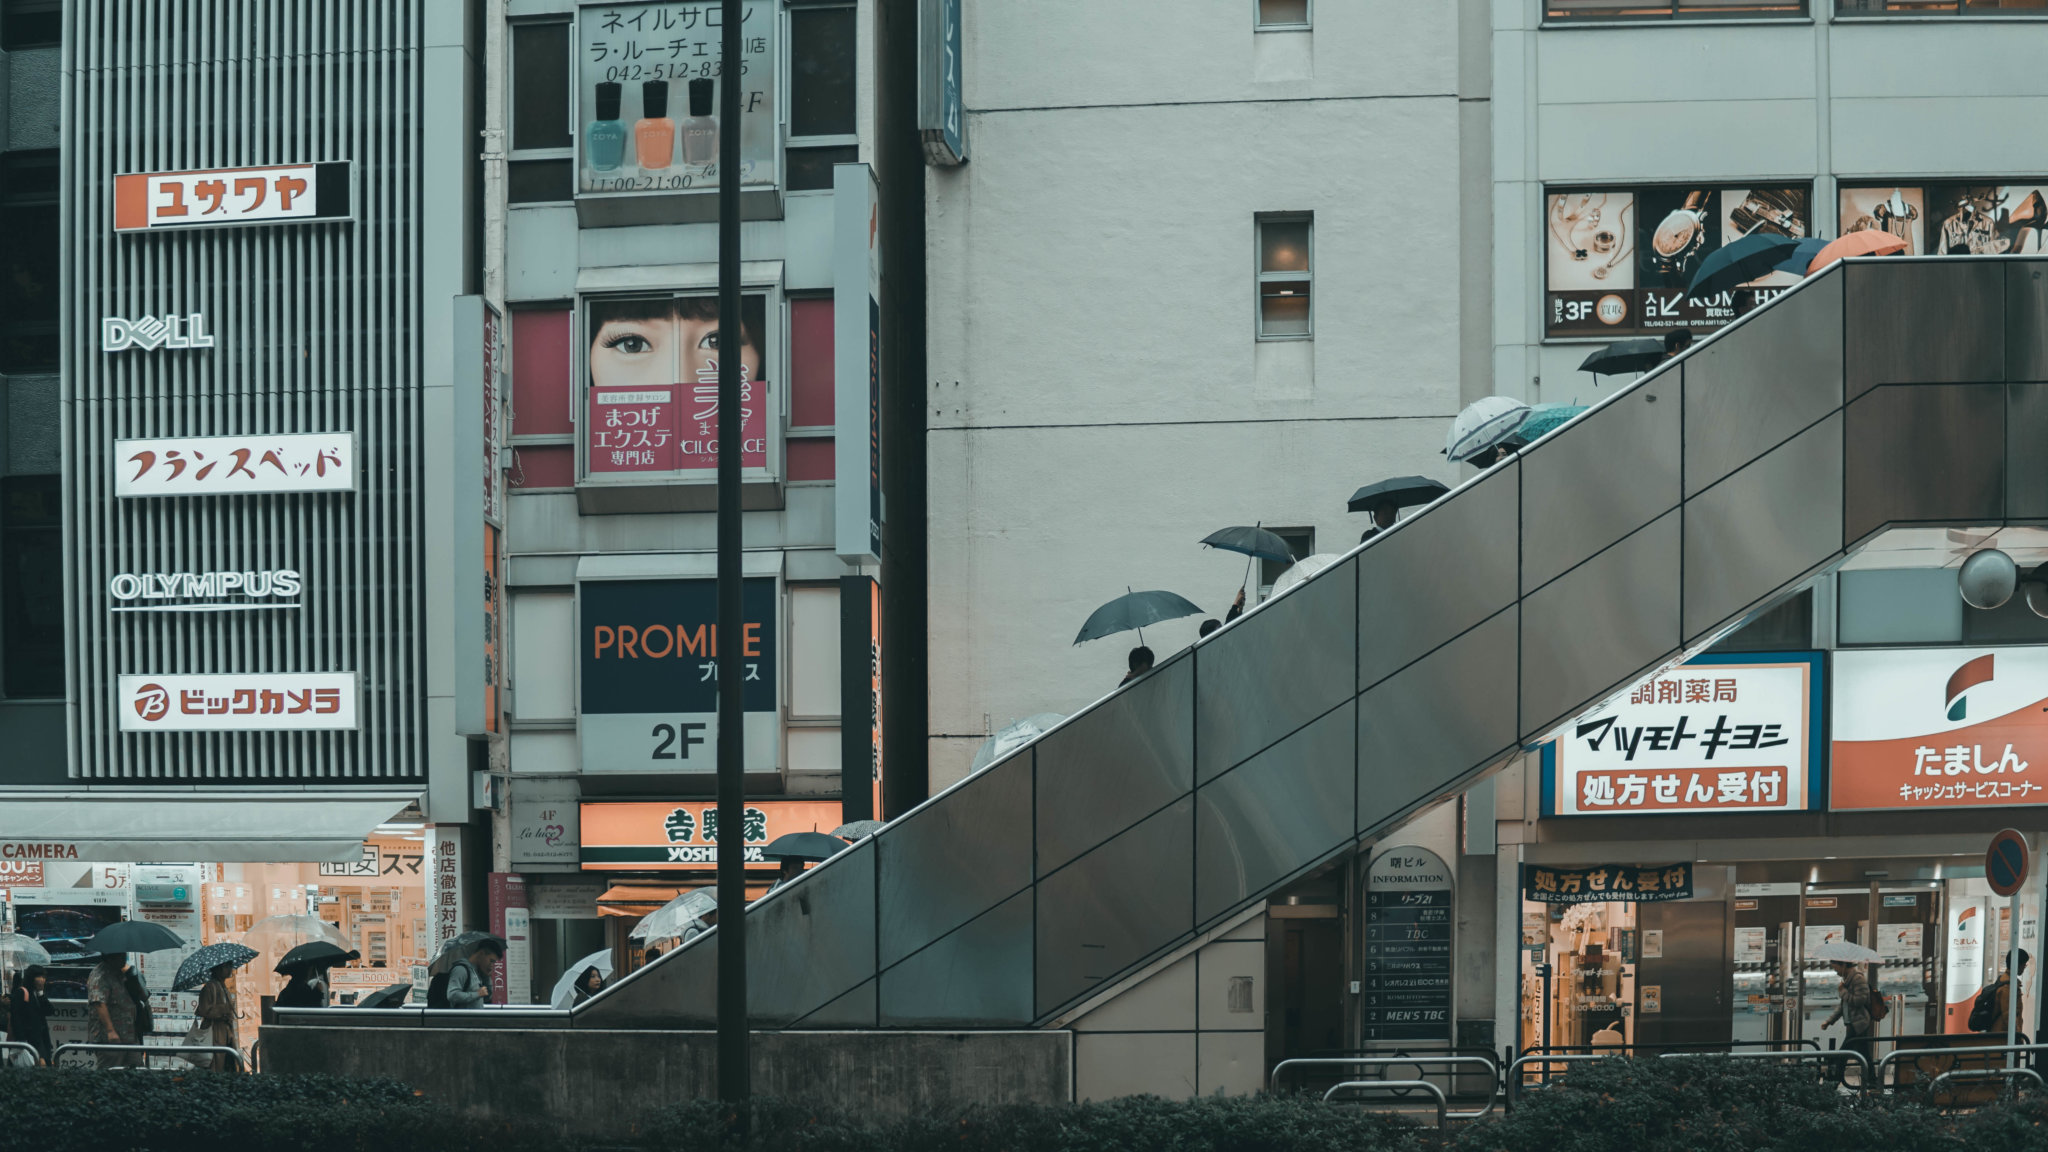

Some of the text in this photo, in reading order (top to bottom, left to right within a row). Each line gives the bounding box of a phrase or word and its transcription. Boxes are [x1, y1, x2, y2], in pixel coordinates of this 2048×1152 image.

[592, 133, 618, 141] ZOYA
[688, 129, 714, 137] ZOYA
[590, 174, 693, 192] 11:00-21:00
[156, 175, 308, 218] ユザワヤ
[1554, 298, 1564, 324] 当ビル
[1565, 301, 1593, 320] 3F
[1645, 292, 1658, 318] 入口
[102, 312, 215, 352] DELL
[605, 406, 661, 427] まつげ
[593, 429, 673, 448] エクステ
[127, 447, 343, 483] フランスベッド
[610, 450, 655, 466] 専門店
[110, 569, 301, 600] OLYMPUS
[594, 622, 762, 660] PROMIE
[698, 660, 761, 682] プス
[1630, 678, 1738, 705] 調剤薬局
[180, 688, 341, 715] ビックカメラ
[651, 722, 707, 760] 2F
[1575, 714, 1790, 762] マツモトキヨシ
[1913, 743, 2029, 777] たましん
[1582, 770, 1783, 807] 処方せん受付
[1899, 780, 2043, 801] キャッシュサービスコーナー
[539, 810, 557, 821] 4F
[2, 843, 79, 859] CAMERA
[667, 847, 765, 862] YOSHIYA
[1373, 874, 1444, 884] INFORMATION
[1534, 866, 1687, 893] 処方せん受付
[1371, 895, 1377, 904] 9
[1371, 912, 1377, 920] 8
[1370, 929, 1429, 939] 7 TBC
[1370, 945, 1377, 954] 6
[1370, 962, 1377, 970] 5
[1370, 979, 1377, 987] 4
[1370, 996, 1377, 1005] 3
[1370, 1010, 1446, 1021] 2 MEN'S TBC
[1370, 1028, 1375, 1037] 1
